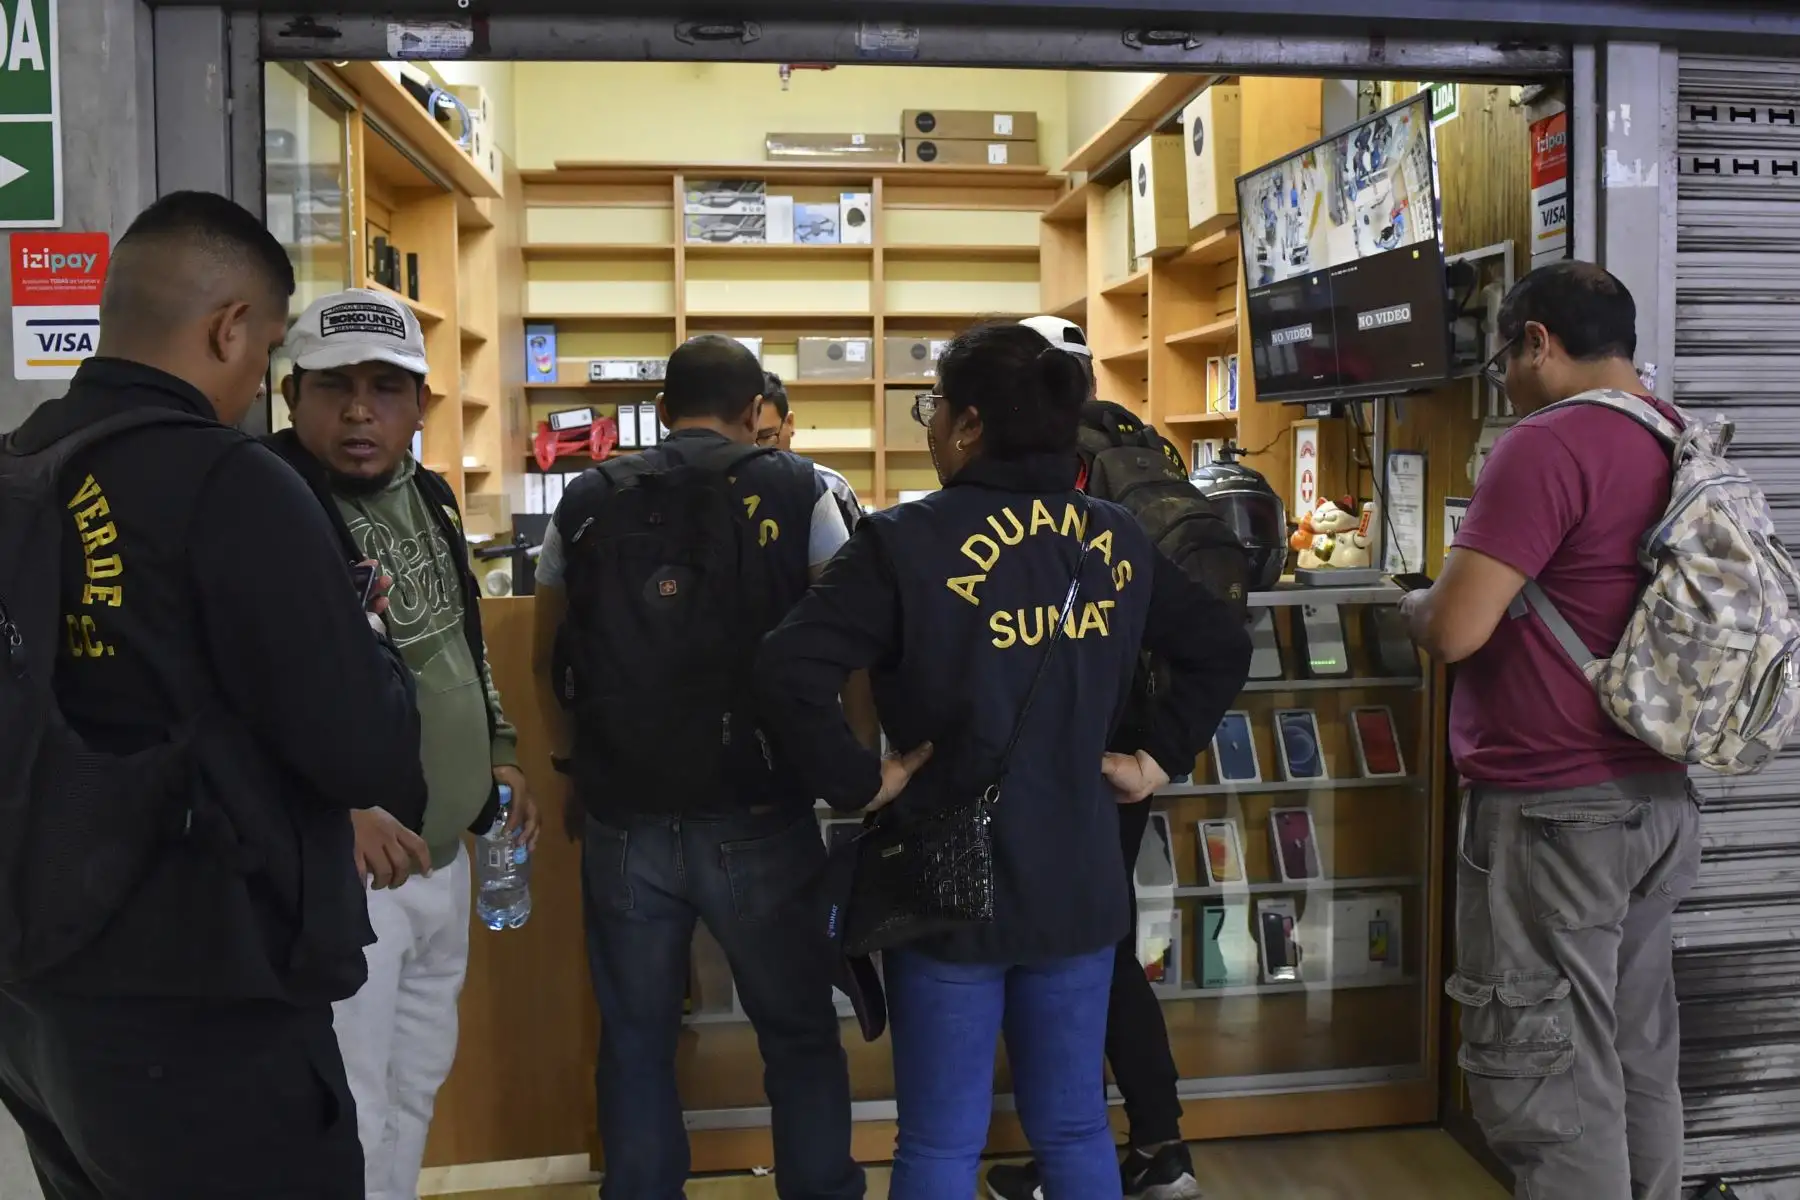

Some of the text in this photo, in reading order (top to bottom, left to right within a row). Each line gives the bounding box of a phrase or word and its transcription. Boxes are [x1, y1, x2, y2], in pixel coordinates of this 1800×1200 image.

[0, 0, 45, 71] A
[1542, 205, 1566, 227] VISA
[22, 247, 97, 273] izipay
[1359, 307, 1410, 328] NO VIDEO
[34, 333, 93, 352] VISA
[1272, 327, 1311, 344] NO VIDEO
[67, 473, 123, 607] VERDE
[946, 499, 1132, 606] ADUANAS
[989, 600, 1115, 649] SUNAT
[1207, 909, 1226, 940] 7
